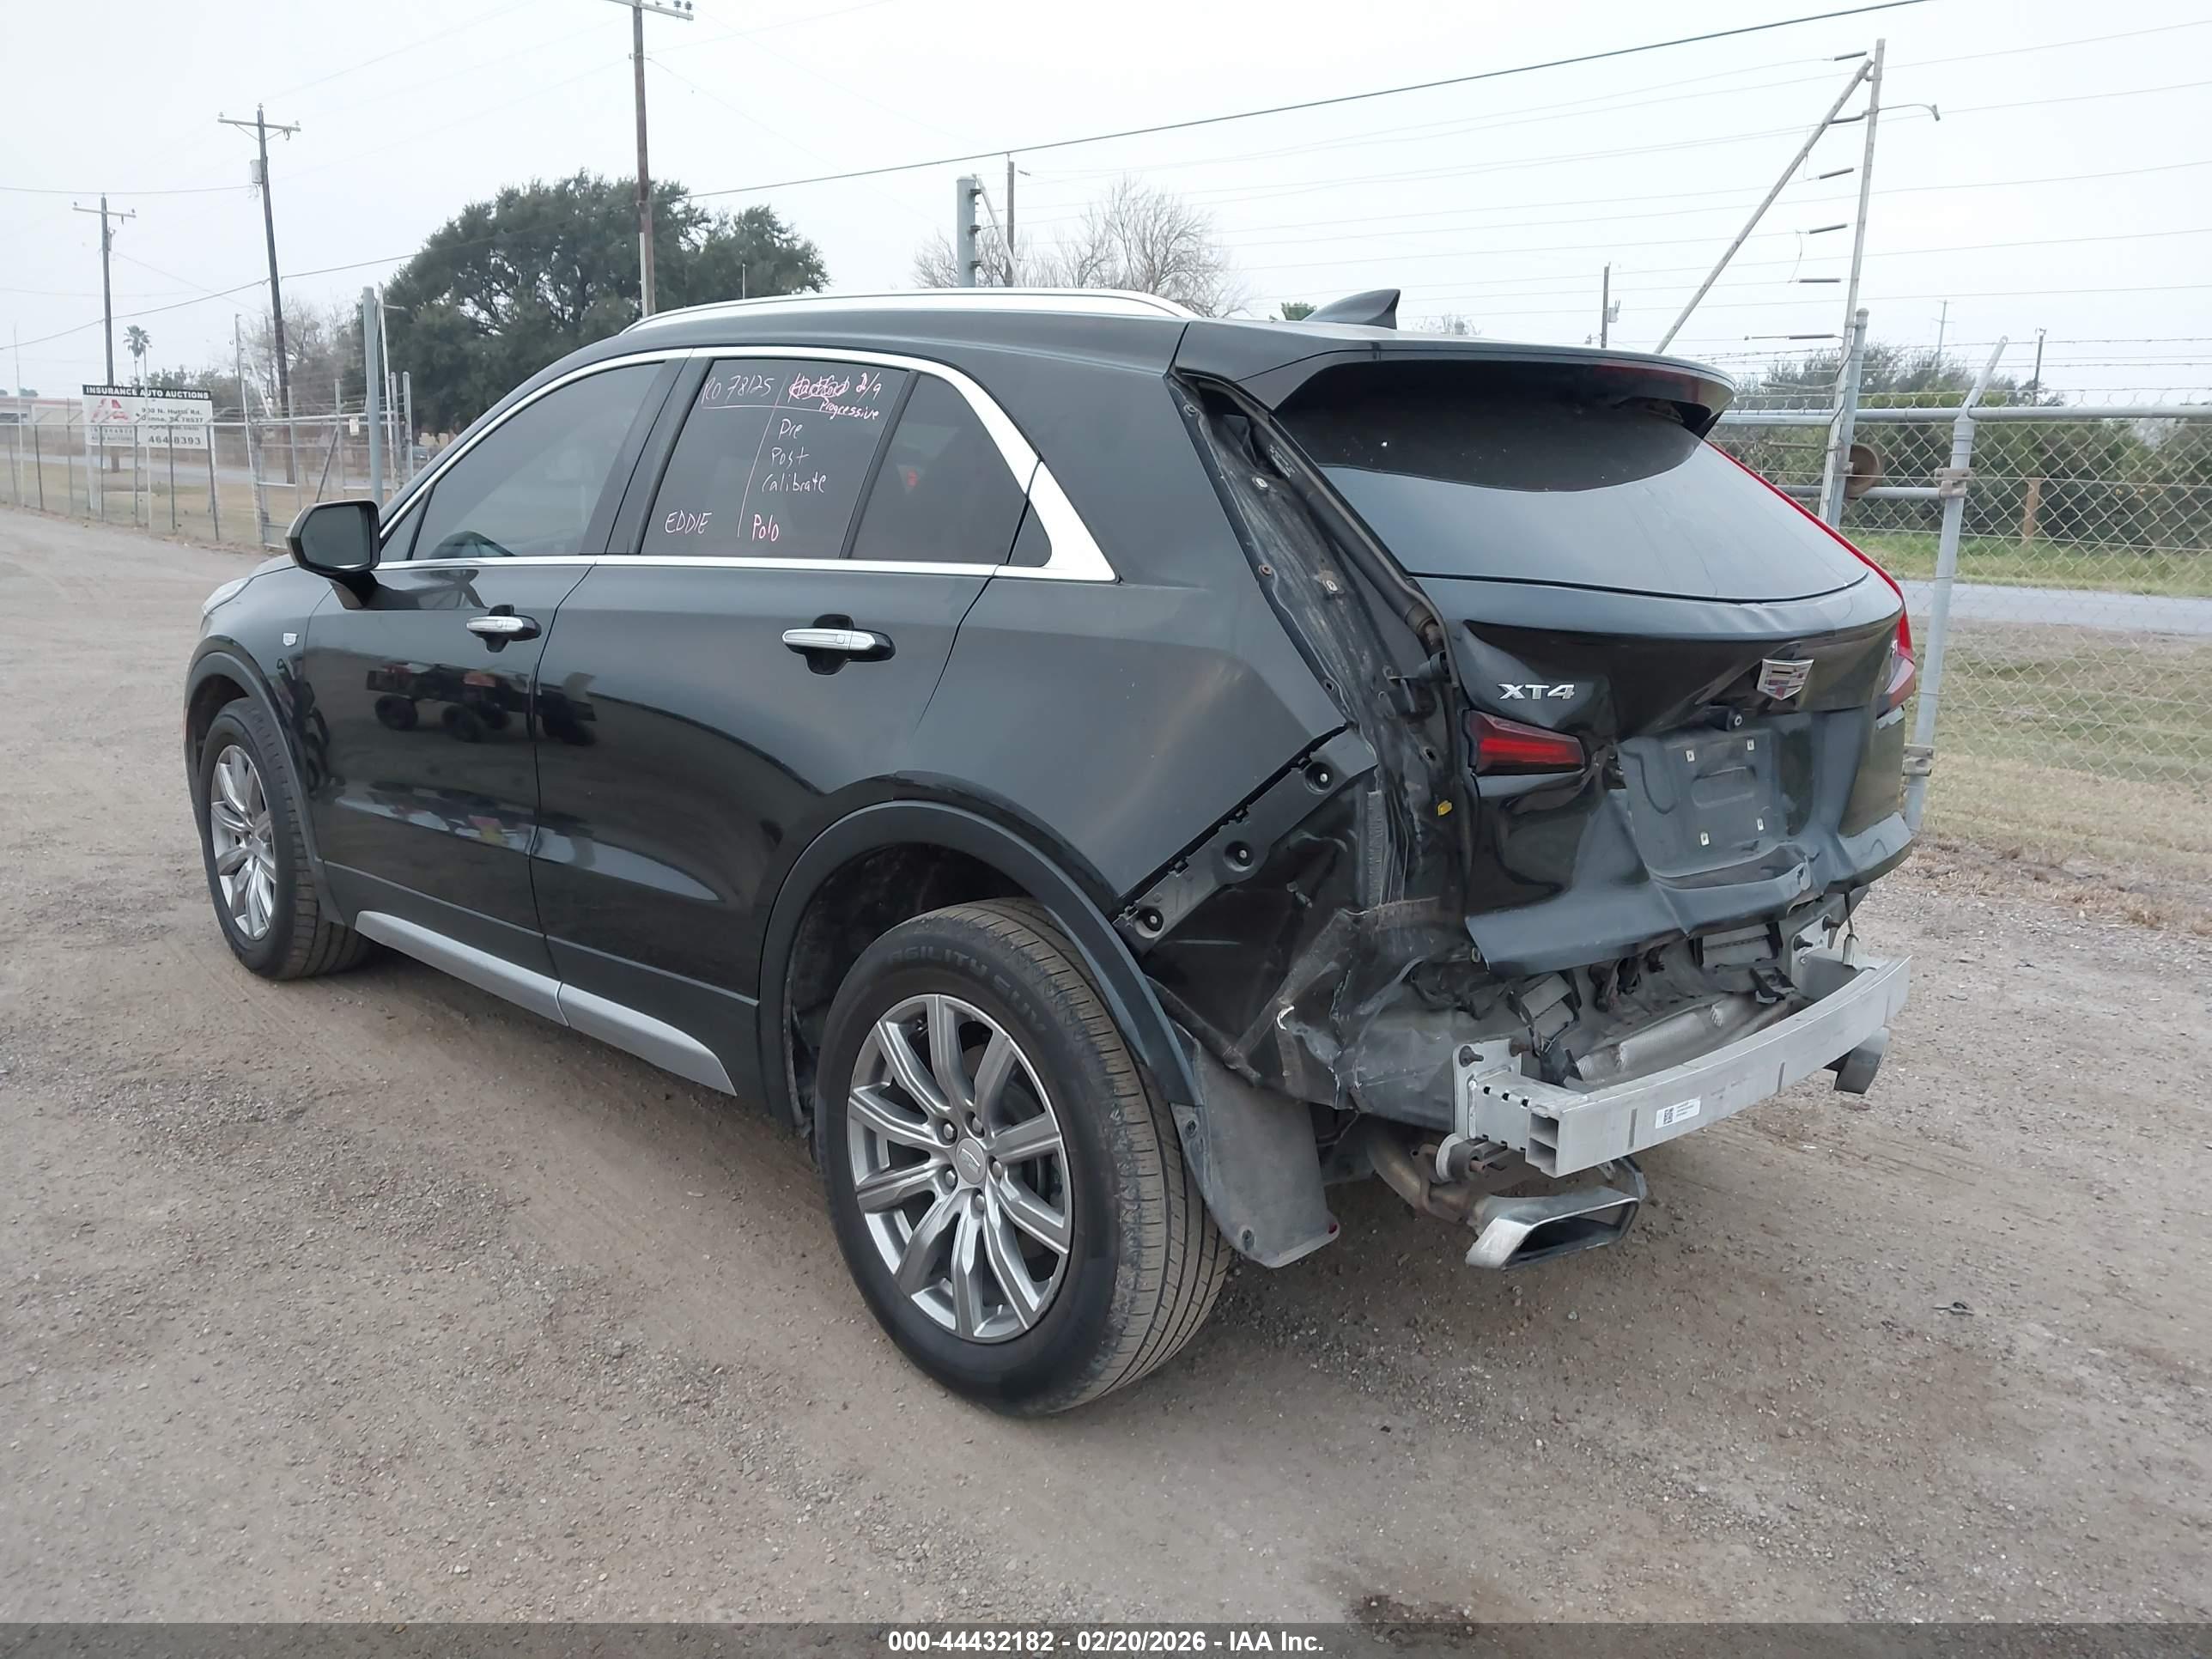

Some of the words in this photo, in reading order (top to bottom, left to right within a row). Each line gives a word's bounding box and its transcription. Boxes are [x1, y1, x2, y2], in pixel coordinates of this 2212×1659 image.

[86, 386, 137, 397] INSURANCE
[165, 390, 210, 399] AUCTIONS
[725, 374, 775, 404] 78125
[818, 398, 880, 421] Progressive
[771, 446, 810, 470] Post
[665, 509, 713, 535] EDDIE
[1498, 684, 1576, 701] XT4
